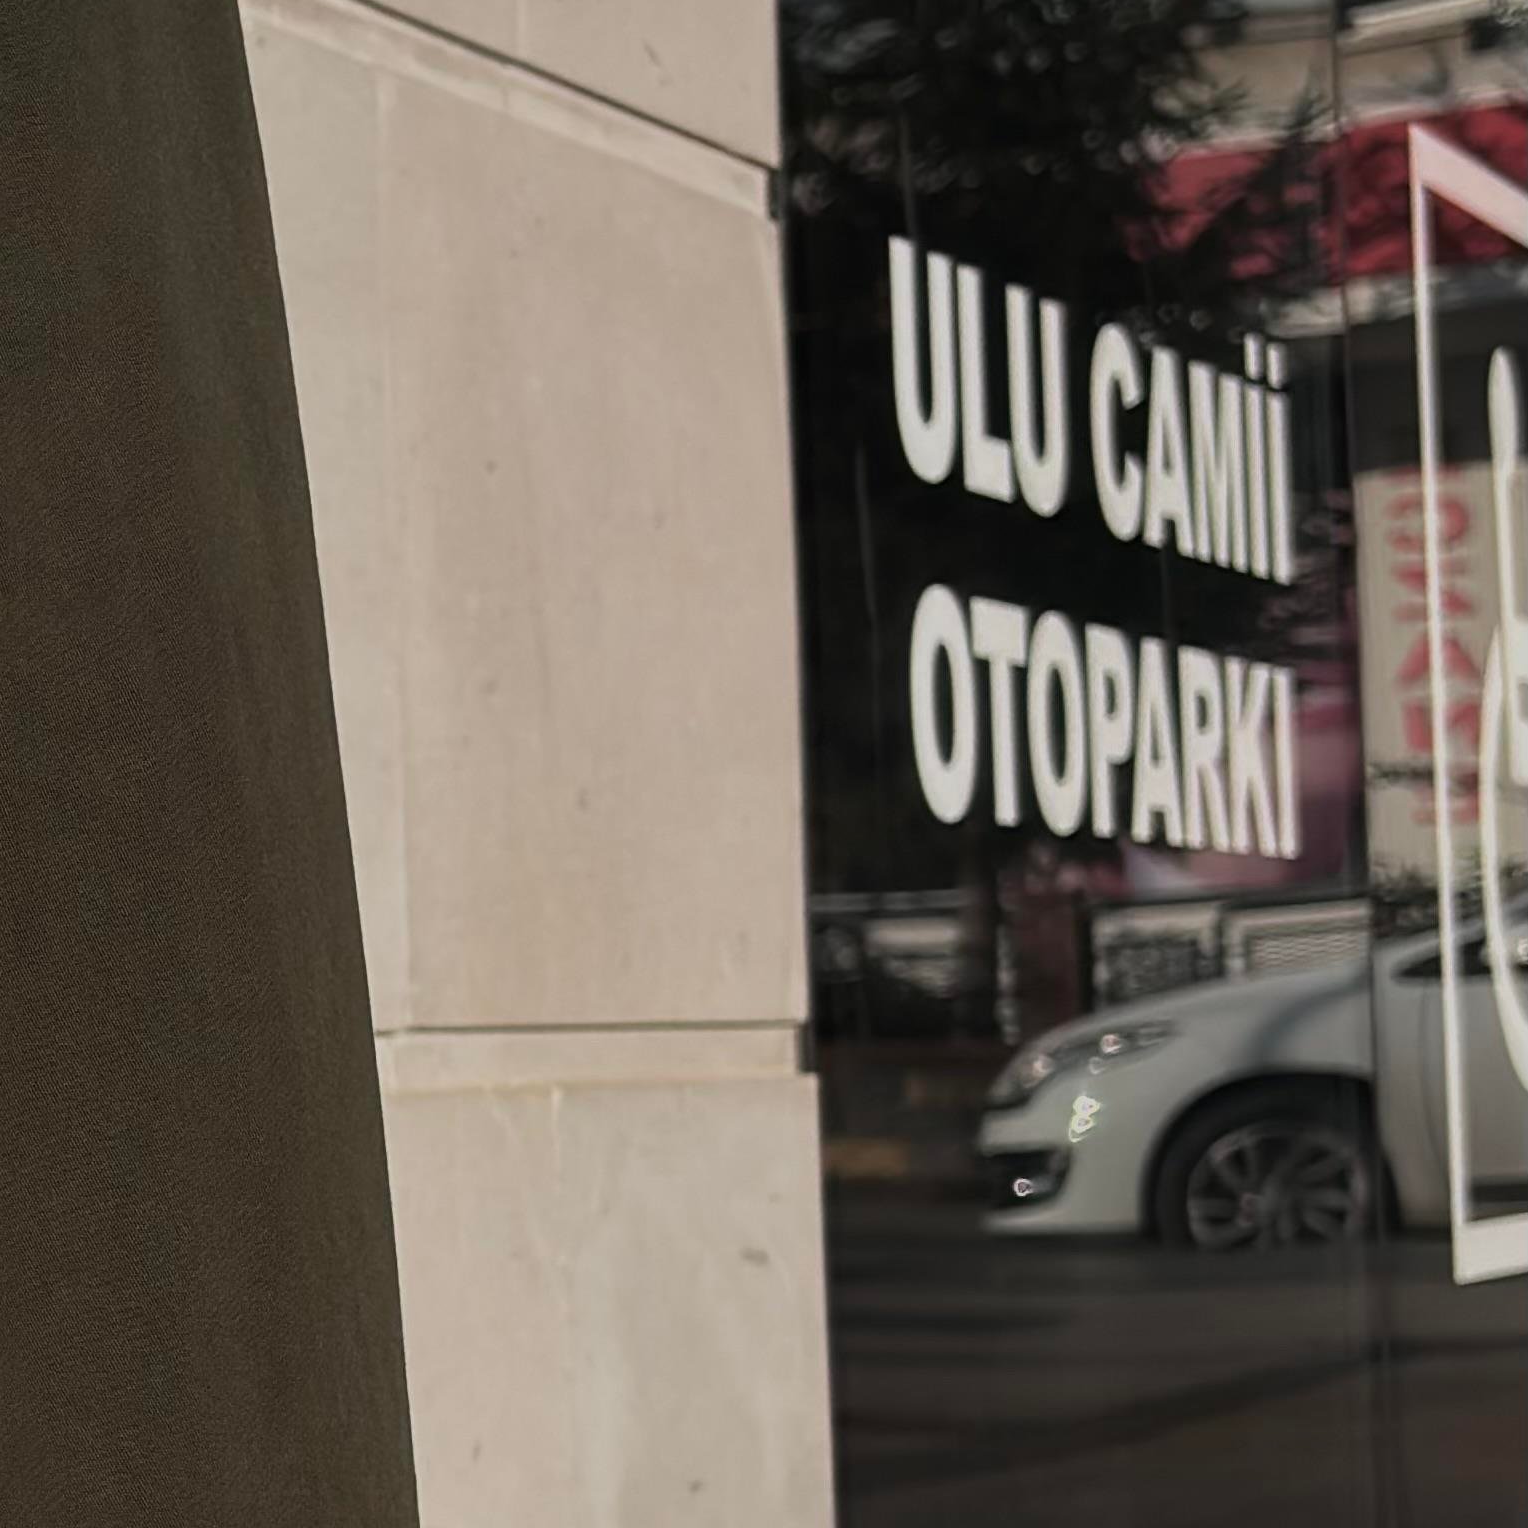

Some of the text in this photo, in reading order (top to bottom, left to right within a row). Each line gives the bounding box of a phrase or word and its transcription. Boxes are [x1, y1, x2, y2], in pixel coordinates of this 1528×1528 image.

[888, 235, 1295, 586] ULU CAMİİ
[908, 584, 1300, 860] OTOPARKI
